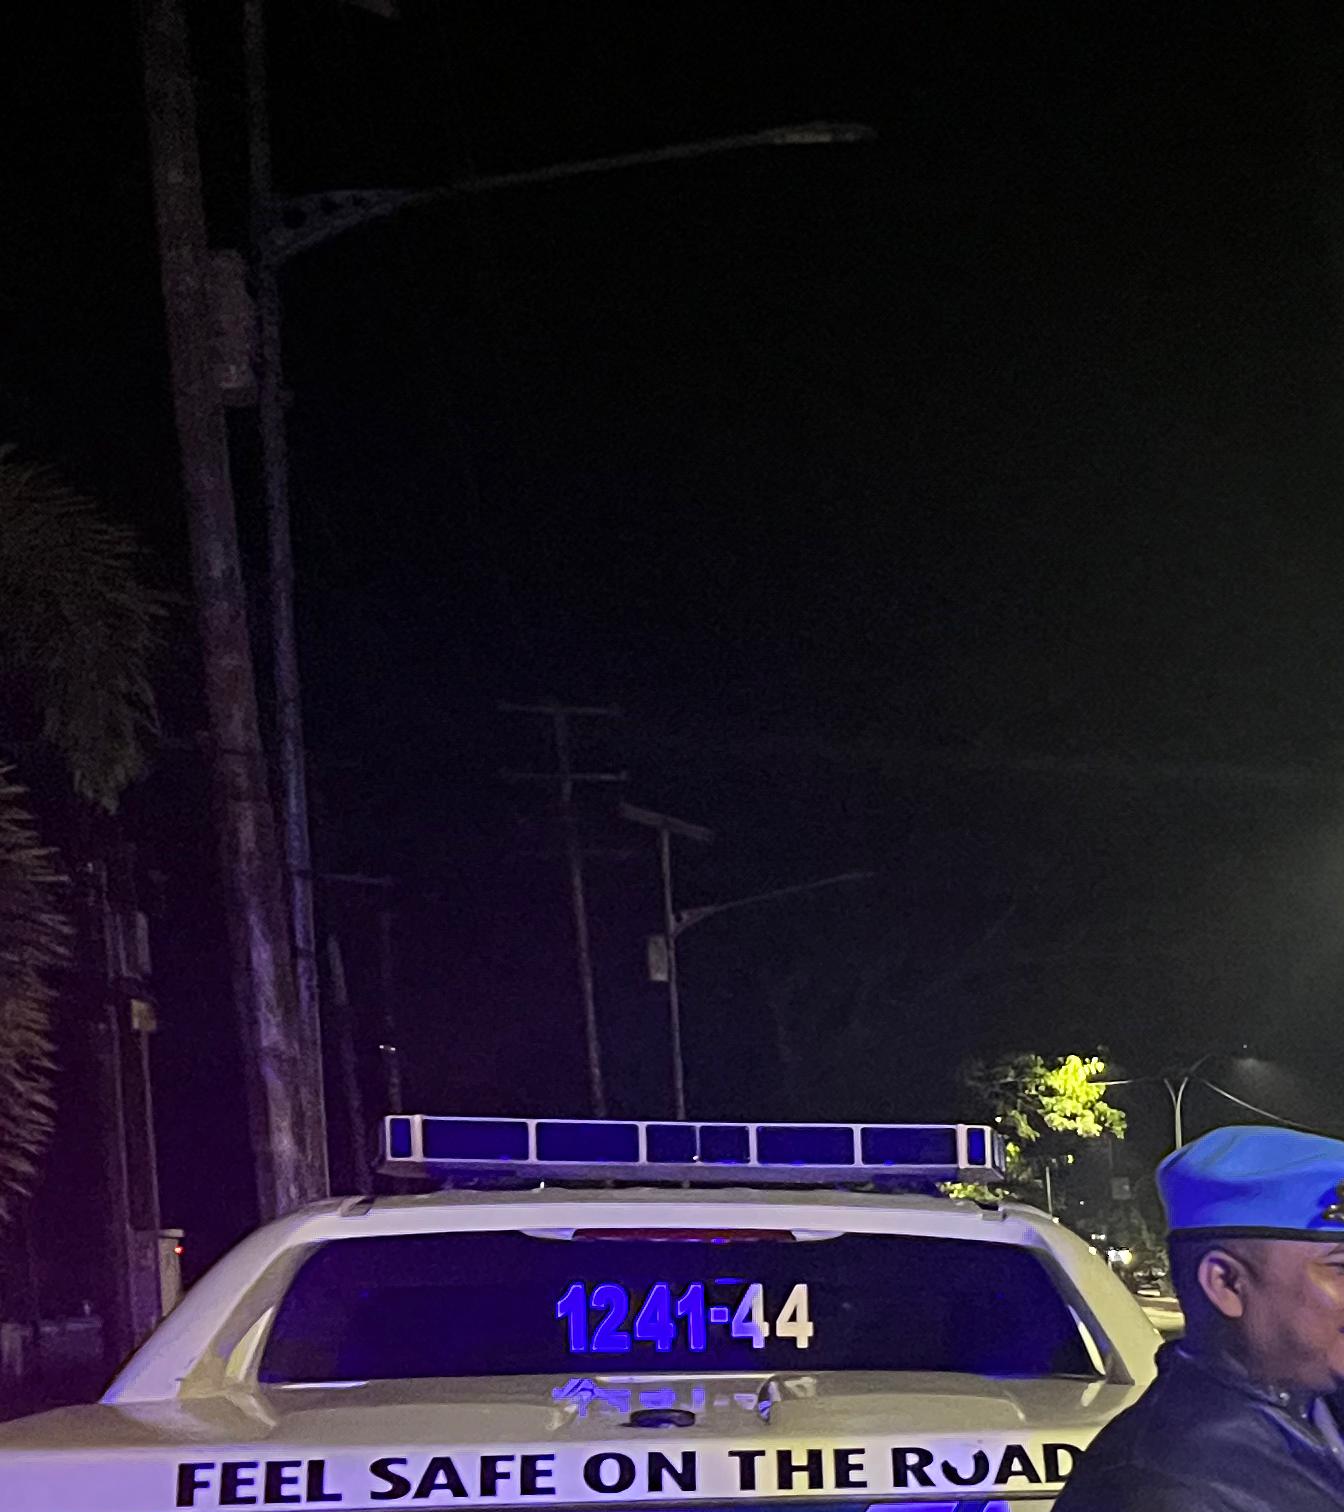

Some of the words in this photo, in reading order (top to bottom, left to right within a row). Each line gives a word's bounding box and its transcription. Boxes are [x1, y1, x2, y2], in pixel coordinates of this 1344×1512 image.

[556, 1282, 814, 1351] 1241-44
[175, 1459, 342, 1507] FEEL
[369, 1453, 556, 1500] SAFE
[583, 1452, 697, 1494] ON
[728, 1447, 868, 1491] THE
[891, 1443, 1085, 1488] ROAD
